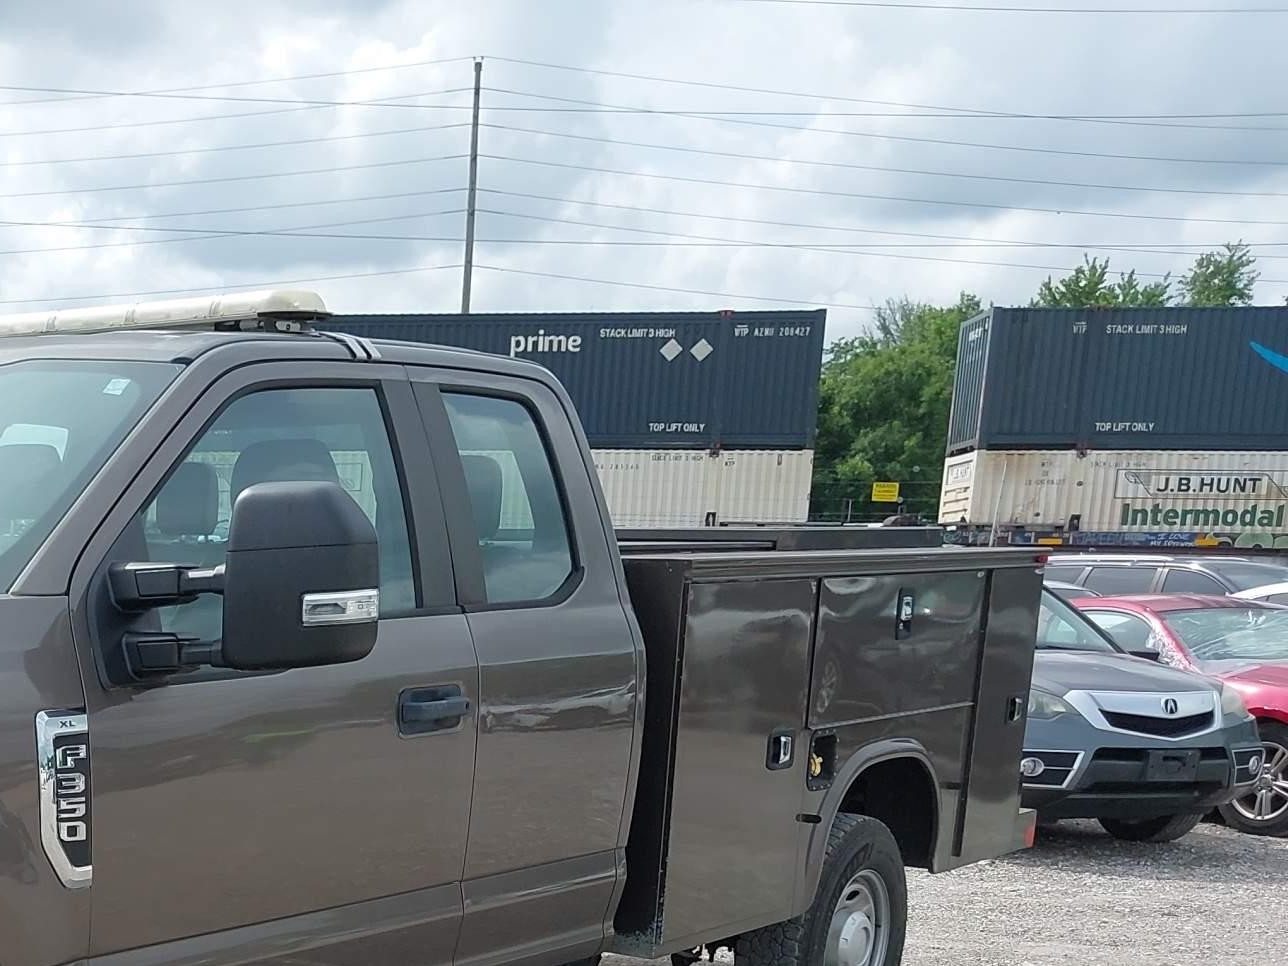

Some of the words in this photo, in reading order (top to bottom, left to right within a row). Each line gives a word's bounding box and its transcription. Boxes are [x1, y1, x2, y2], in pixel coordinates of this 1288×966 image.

[600, 328, 626, 338] STACK
[628, 328, 648, 338] LIMIT
[649, 328, 654, 338] 3
[656, 328, 676, 338] HIGH
[1106, 324, 1133, 334] STACK
[1136, 324, 1157, 334] LIMIT
[1160, 324, 1165, 334] 3
[1166, 324, 1188, 334] HIGH
[510, 330, 582, 358] prime
[649, 422, 665, 432] TOP
[666, 423, 682, 432] LIFT
[683, 423, 706, 432] ONLY
[1095, 422, 1112, 432] TOP
[1113, 423, 1131, 432] LIFT
[1132, 423, 1155, 432] ONLY
[1120, 503, 1285, 527] Intermodal
[59, 719, 76, 728] XL
